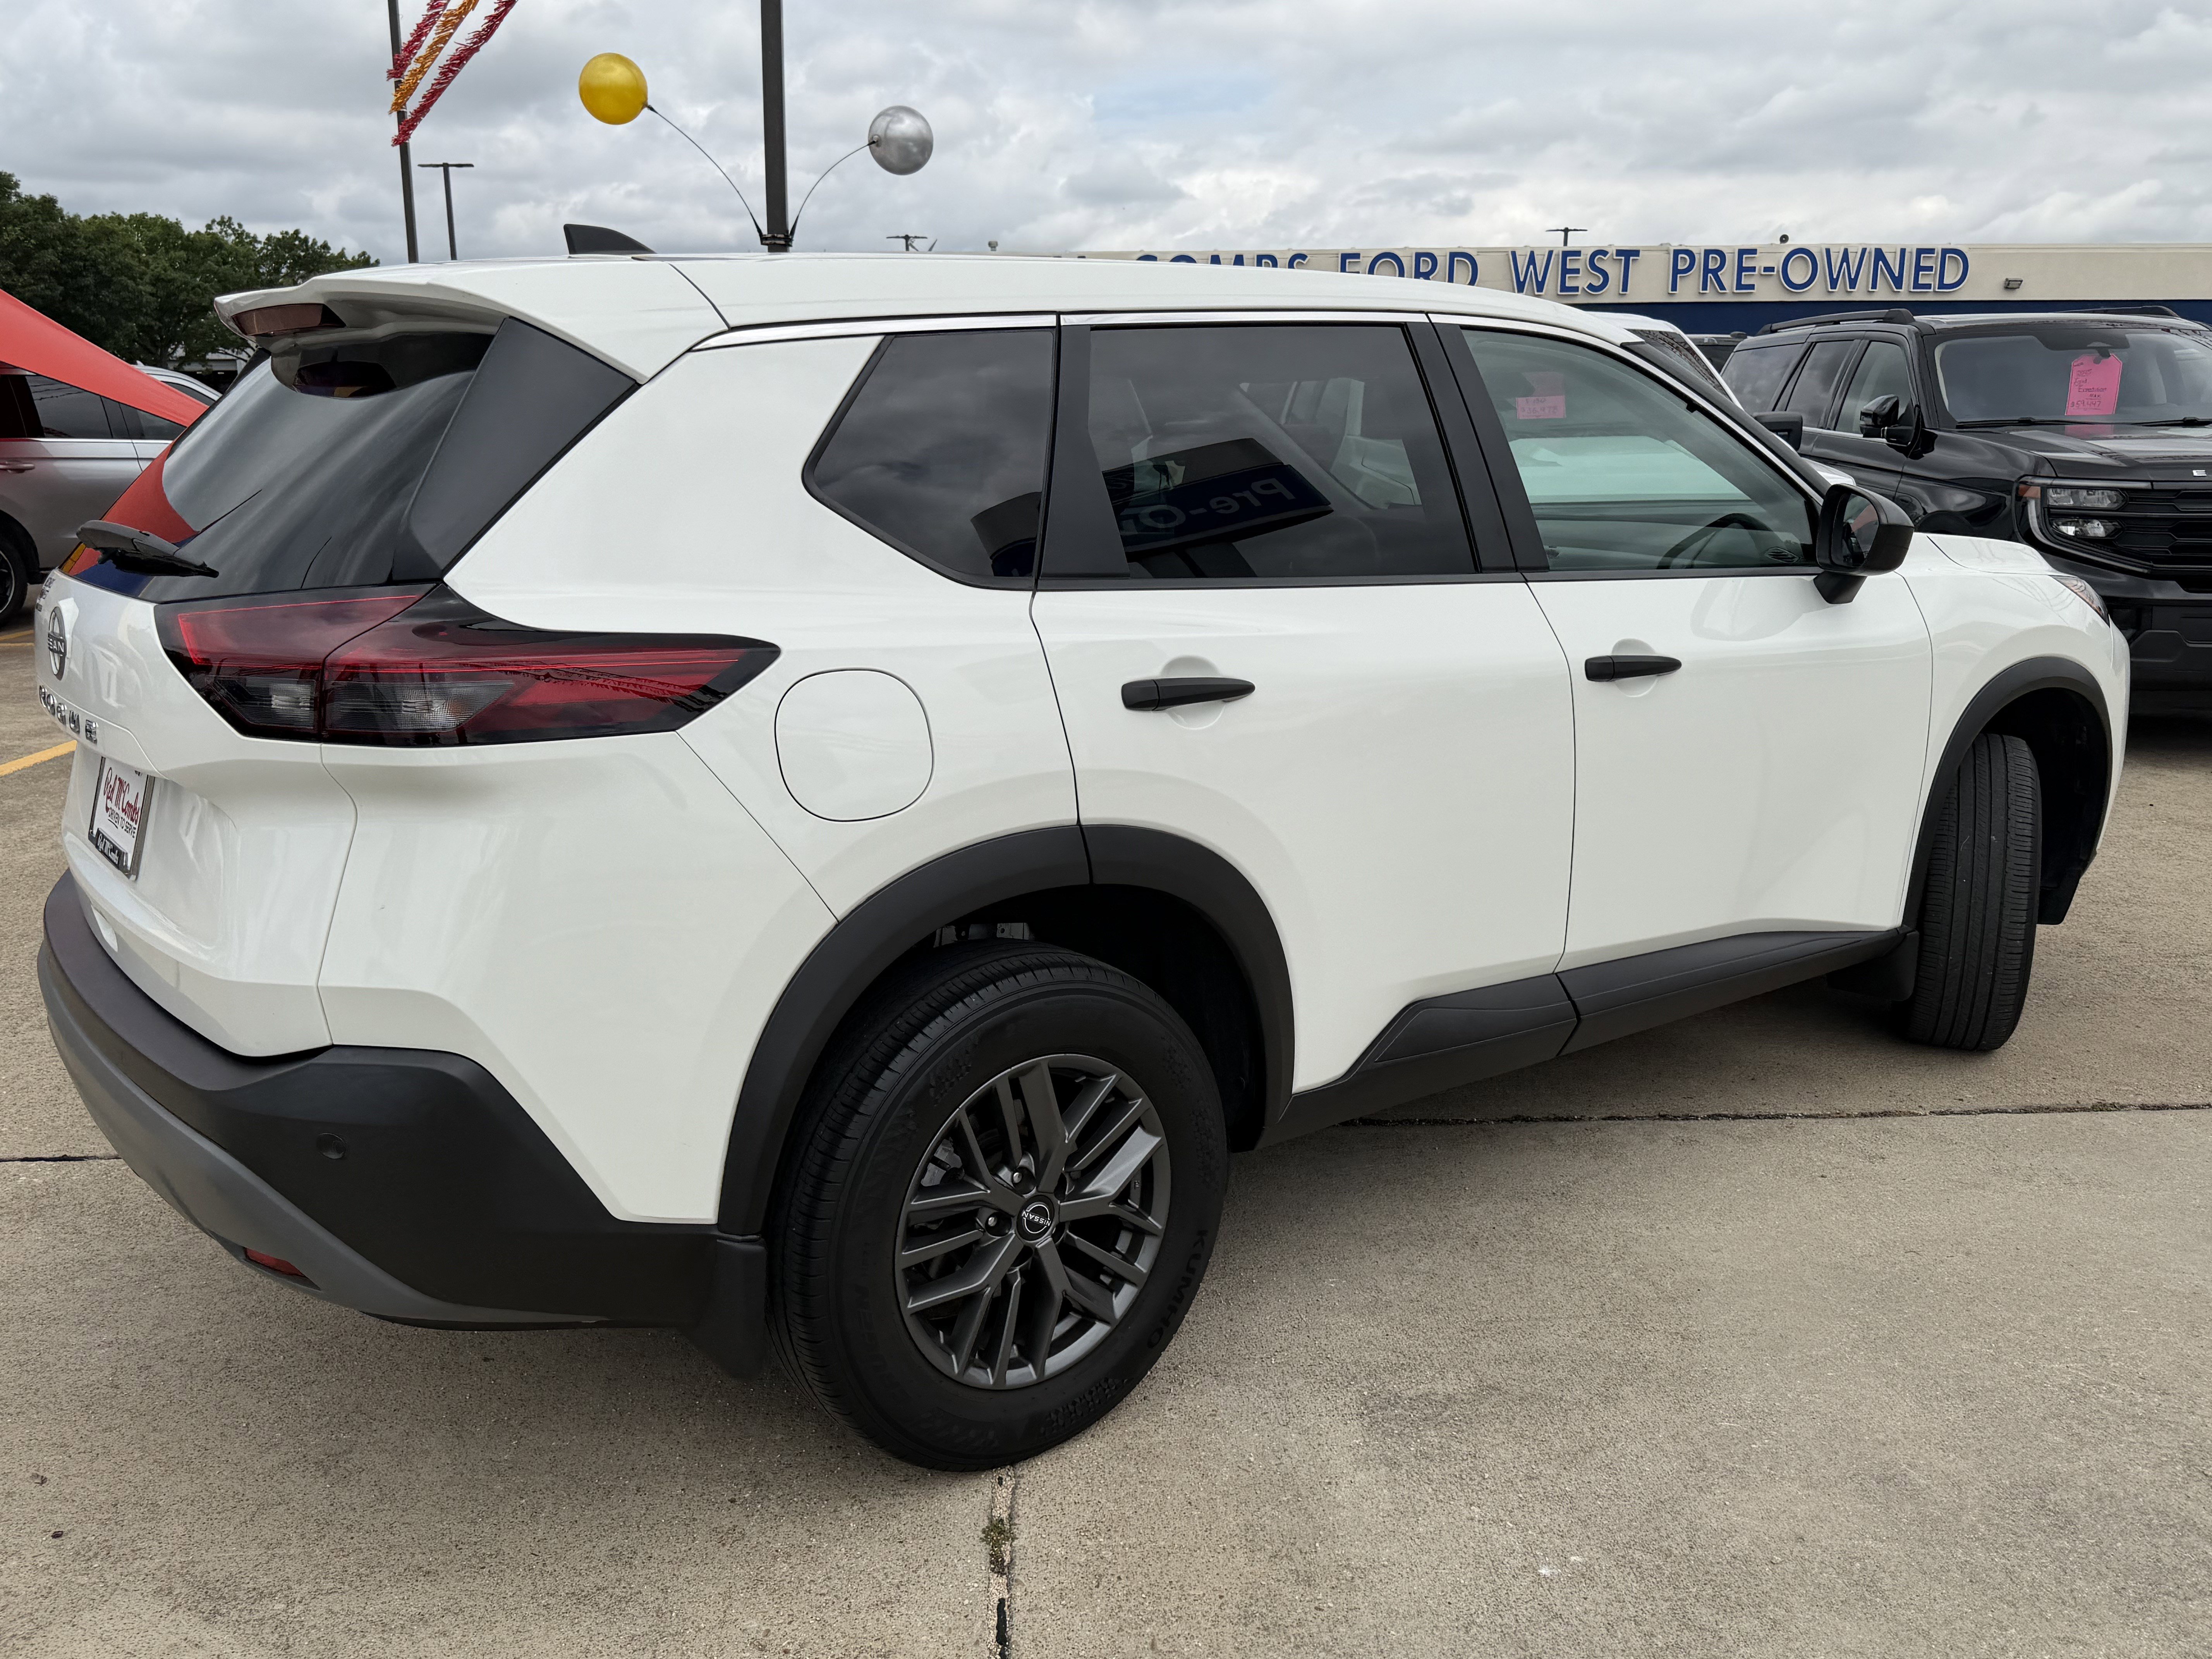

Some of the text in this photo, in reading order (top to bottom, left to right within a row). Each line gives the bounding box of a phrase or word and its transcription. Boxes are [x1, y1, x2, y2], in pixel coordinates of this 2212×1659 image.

[1509, 249, 1641, 295] WEST
[1668, 247, 1970, 293] PRE-OWNED
[120, 816, 125, 829] TO
[1022, 1211, 1051, 1226] NISSAN
[1147, 1230, 1209, 1348] KUMHO
